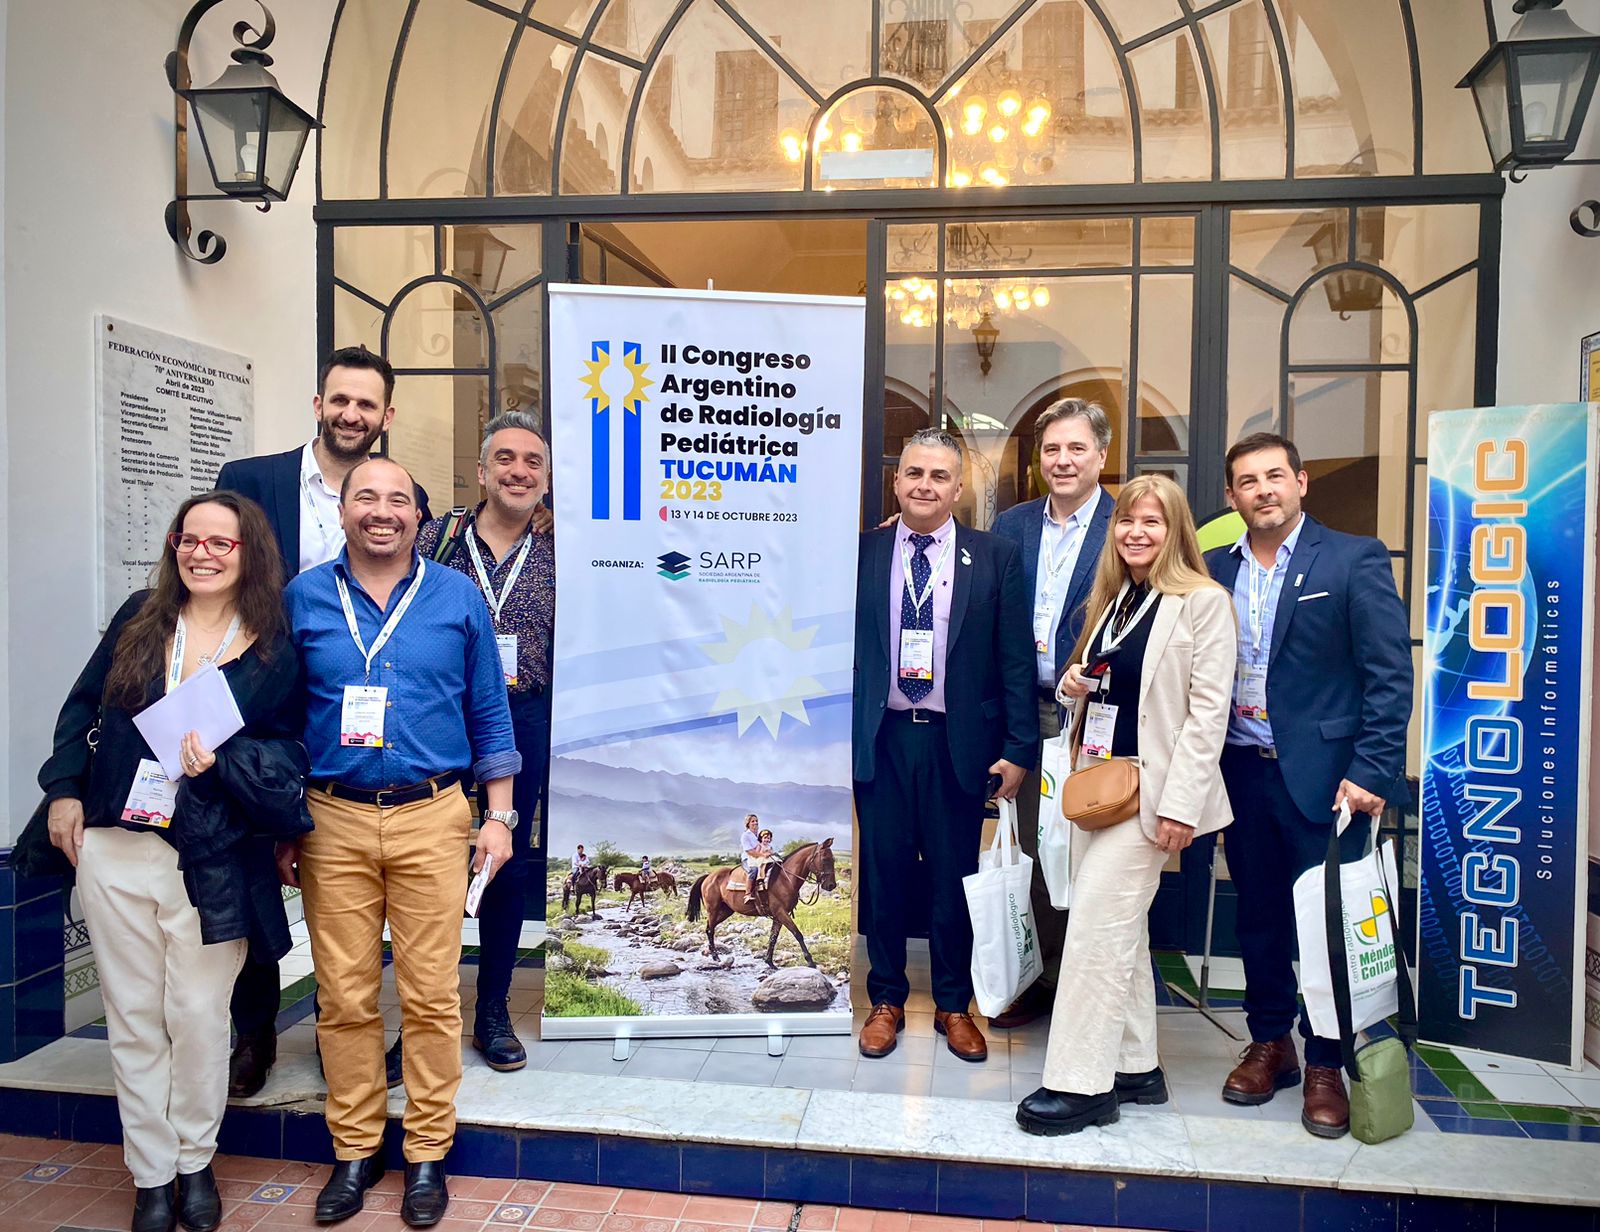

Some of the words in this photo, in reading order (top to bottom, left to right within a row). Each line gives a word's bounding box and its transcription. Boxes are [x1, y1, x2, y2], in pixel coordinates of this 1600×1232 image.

[108, 341, 160, 362] FEDERACIÓN
[162, 356, 206, 374] ECONÓMICA
[208, 368, 218, 376] DE
[218, 370, 250, 384] TUCUMÁN
[661, 344, 677, 364] II
[682, 345, 811, 374] Congreso
[166, 369, 214, 386] ANIVERSARIO
[166, 378, 180, 388] Abril
[191, 384, 205, 394] 2023
[660, 374, 797, 402] Argentino
[120, 392, 149, 402] Presidente
[156, 386, 180, 398] COMITÉ
[181, 392, 214, 406] EJECUTIVO
[121, 418, 148, 428] Secretario
[148, 422, 168, 432] General
[660, 403, 694, 423] de
[699, 404, 841, 435] Radiología
[121, 426, 144, 436] Tesorero
[121, 436, 152, 446] Protesorero
[121, 448, 148, 458] Secretario
[156, 453, 180, 462] Comercio
[660, 432, 798, 457] Pediátrica
[121, 456, 148, 466] Secretario
[121, 466, 148, 475] Secretario
[660, 456, 797, 484] TUCUMÁN
[660, 480, 722, 502] 2023
[670, 510, 681, 519] 13
[684, 510, 690, 519] Y
[693, 510, 704, 520] 14
[706, 511, 720, 520] DE
[722, 512, 770, 522] OCTUBRE
[772, 513, 798, 522] 2023
[591, 560, 644, 568] ORGANIZA:
[700, 552, 762, 570] SARP
[1540, 580, 1560, 737] Informáticas
[1457, 437, 1529, 1021] TECNOLOGIC
[1536, 746, 1556, 881] Soluciones
[1008, 893, 1021, 940] radiológico
[1359, 943, 1396, 967] Ménde
[1349, 954, 1360, 984] centro
[1360, 956, 1396, 980] Collad
